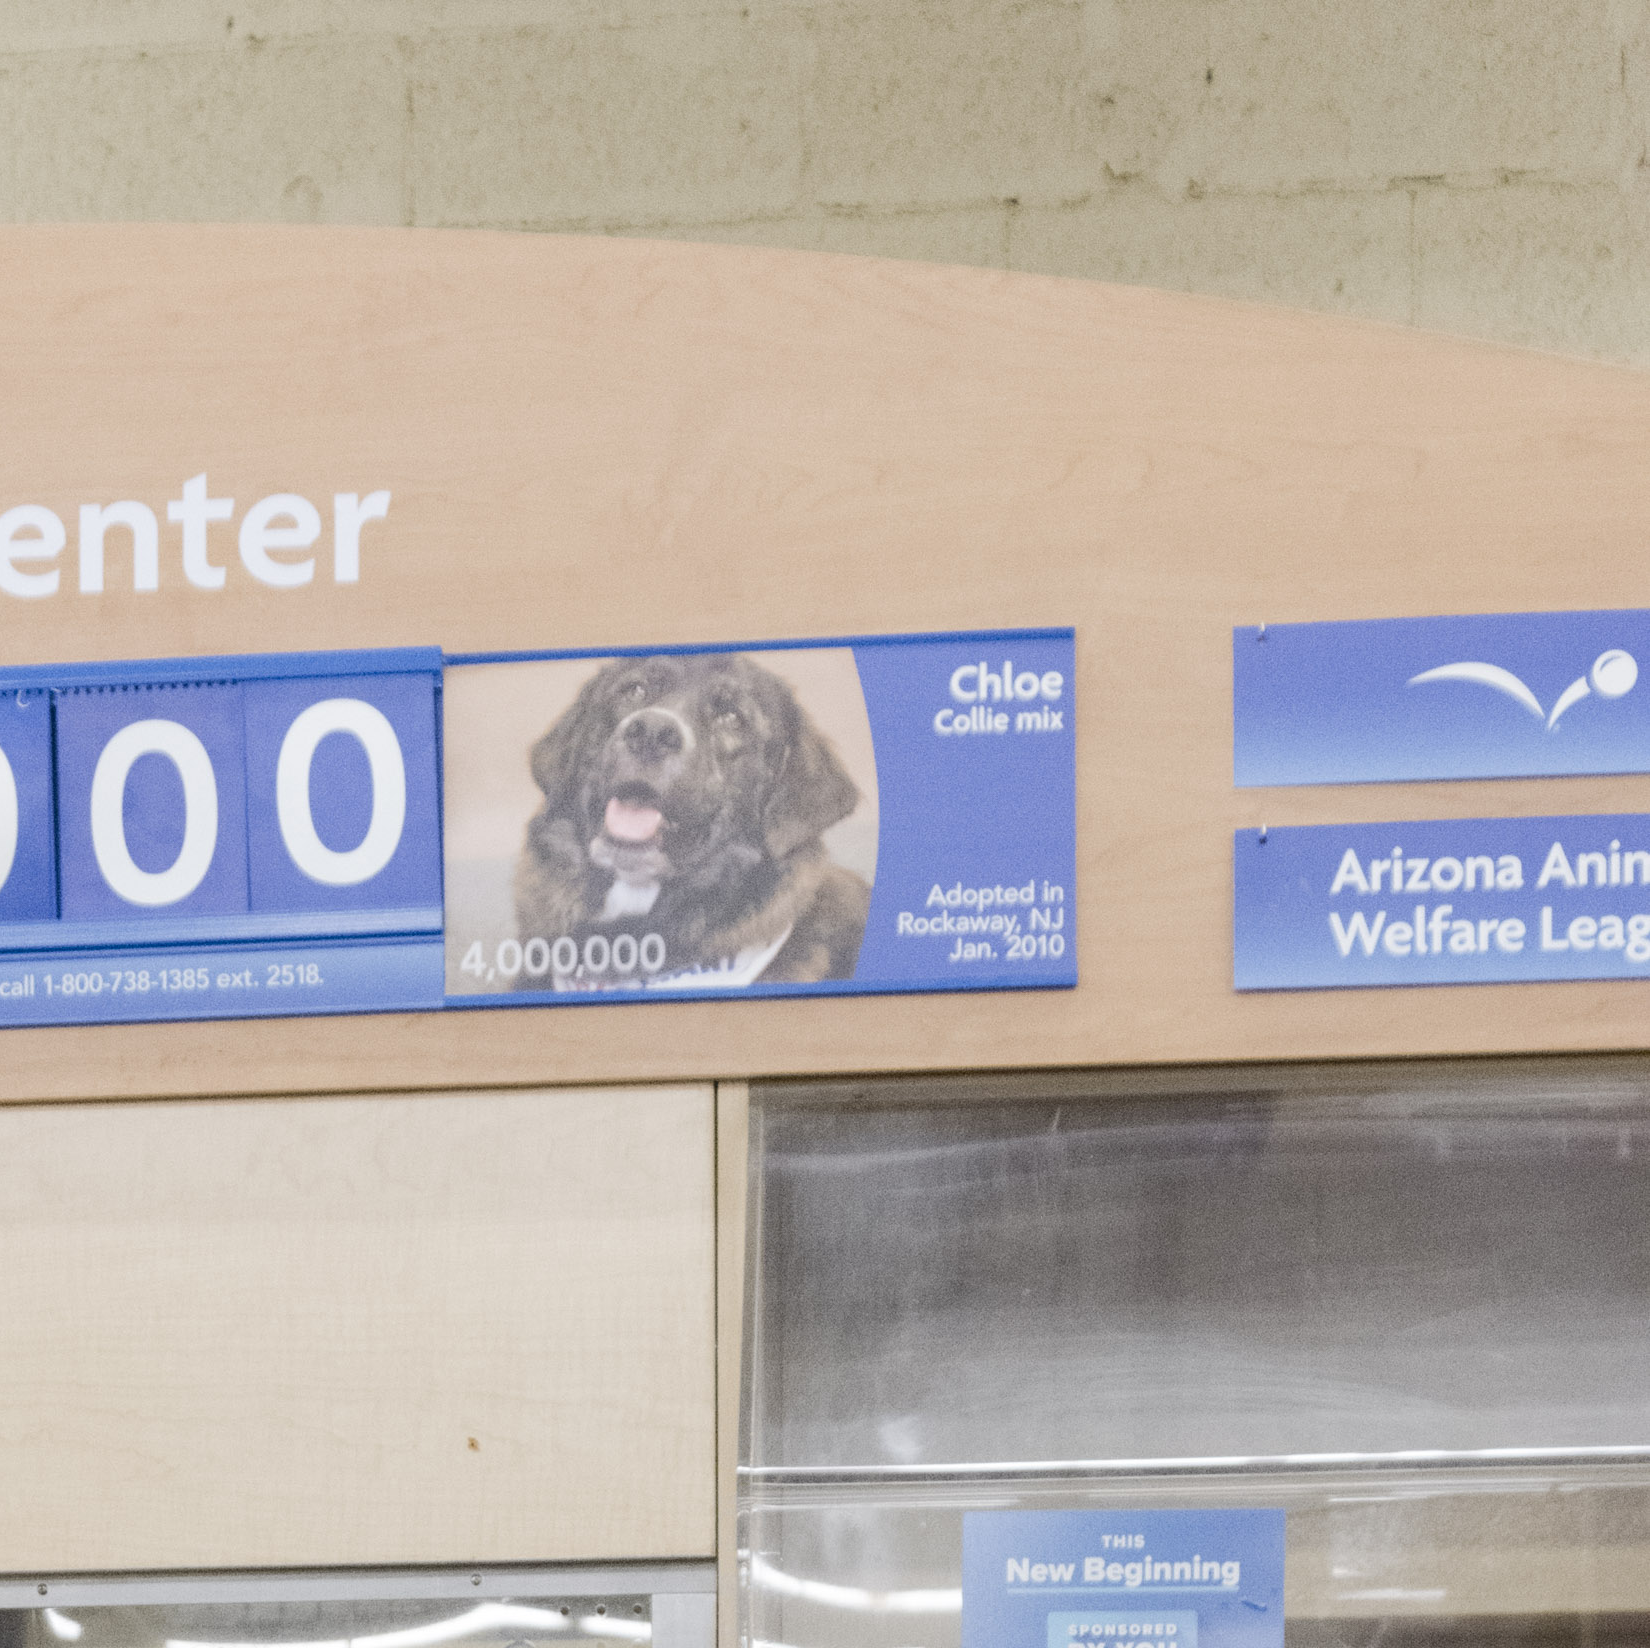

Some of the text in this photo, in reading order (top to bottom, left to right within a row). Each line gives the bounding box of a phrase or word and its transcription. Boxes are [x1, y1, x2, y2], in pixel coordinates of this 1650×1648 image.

[949, 662, 1064, 701] Chloe
[933, 706, 1064, 734] Collie mix
[1330, 848, 1525, 893] Arizona
[926, 880, 1064, 910] Adopted in
[897, 907, 1064, 937] Rockaway, NJ
[1329, 906, 1527, 956] Welfare
[460, 933, 667, 978] 4,000,000
[949, 934, 1065, 962] Jan. 2010
[43, 968, 210, 995] 1-800-738-1385
[216, 969, 259, 988] ext.
[266, 963, 324, 986] 2518.
[1101, 1534, 1145, 1549] THIS
[1007, 1555, 1241, 1587] New Beginning
[1066, 1623, 1177, 1636] SPONSORED
